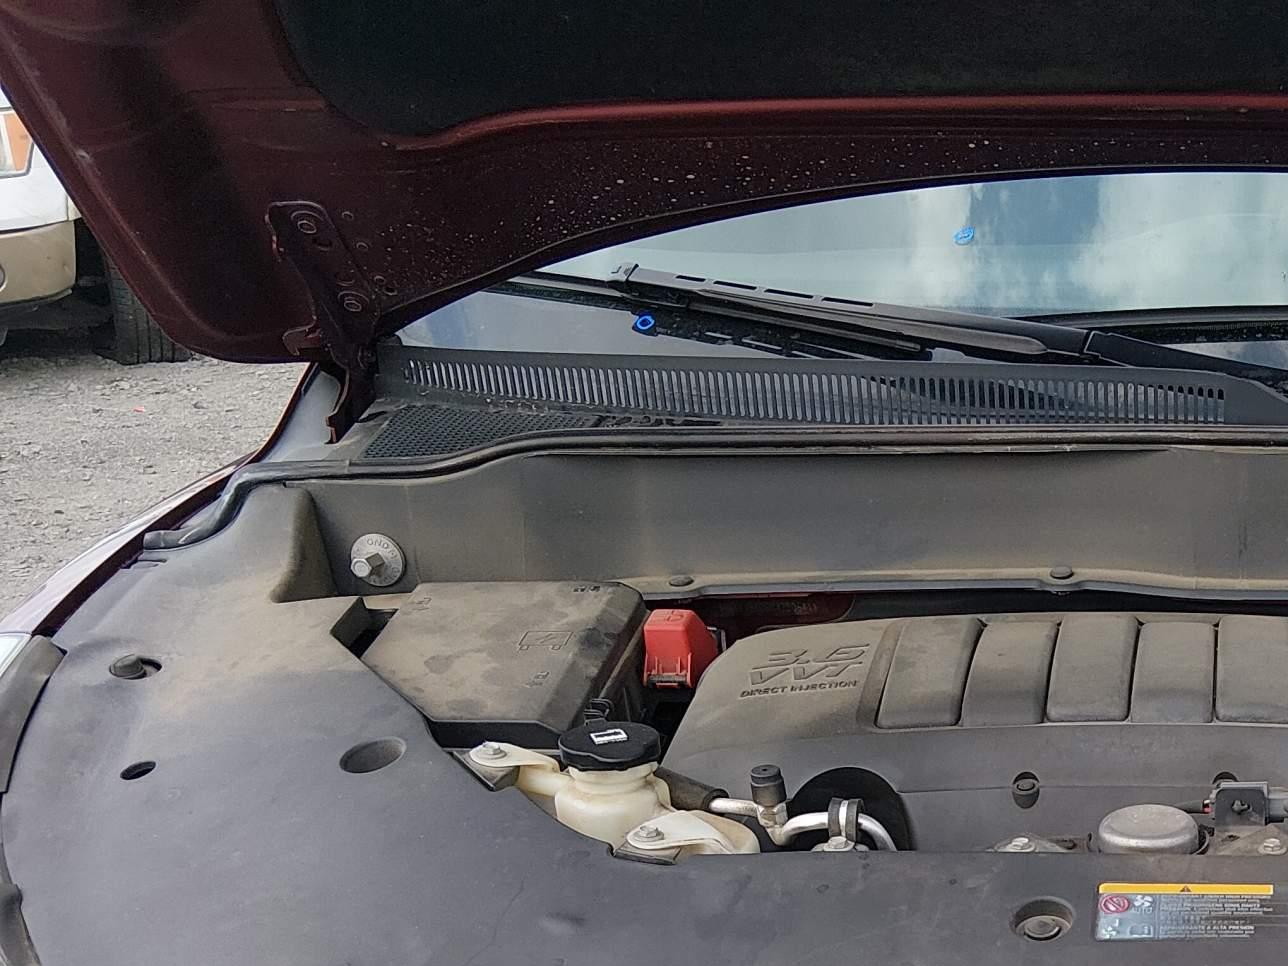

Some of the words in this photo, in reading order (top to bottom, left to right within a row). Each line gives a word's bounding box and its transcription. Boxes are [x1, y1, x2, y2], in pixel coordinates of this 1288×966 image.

[751, 643, 870, 671] 3.6
[749, 661, 863, 686] VVT
[740, 686, 788, 698] DIRECT
[790, 679, 858, 694] INJECTION
